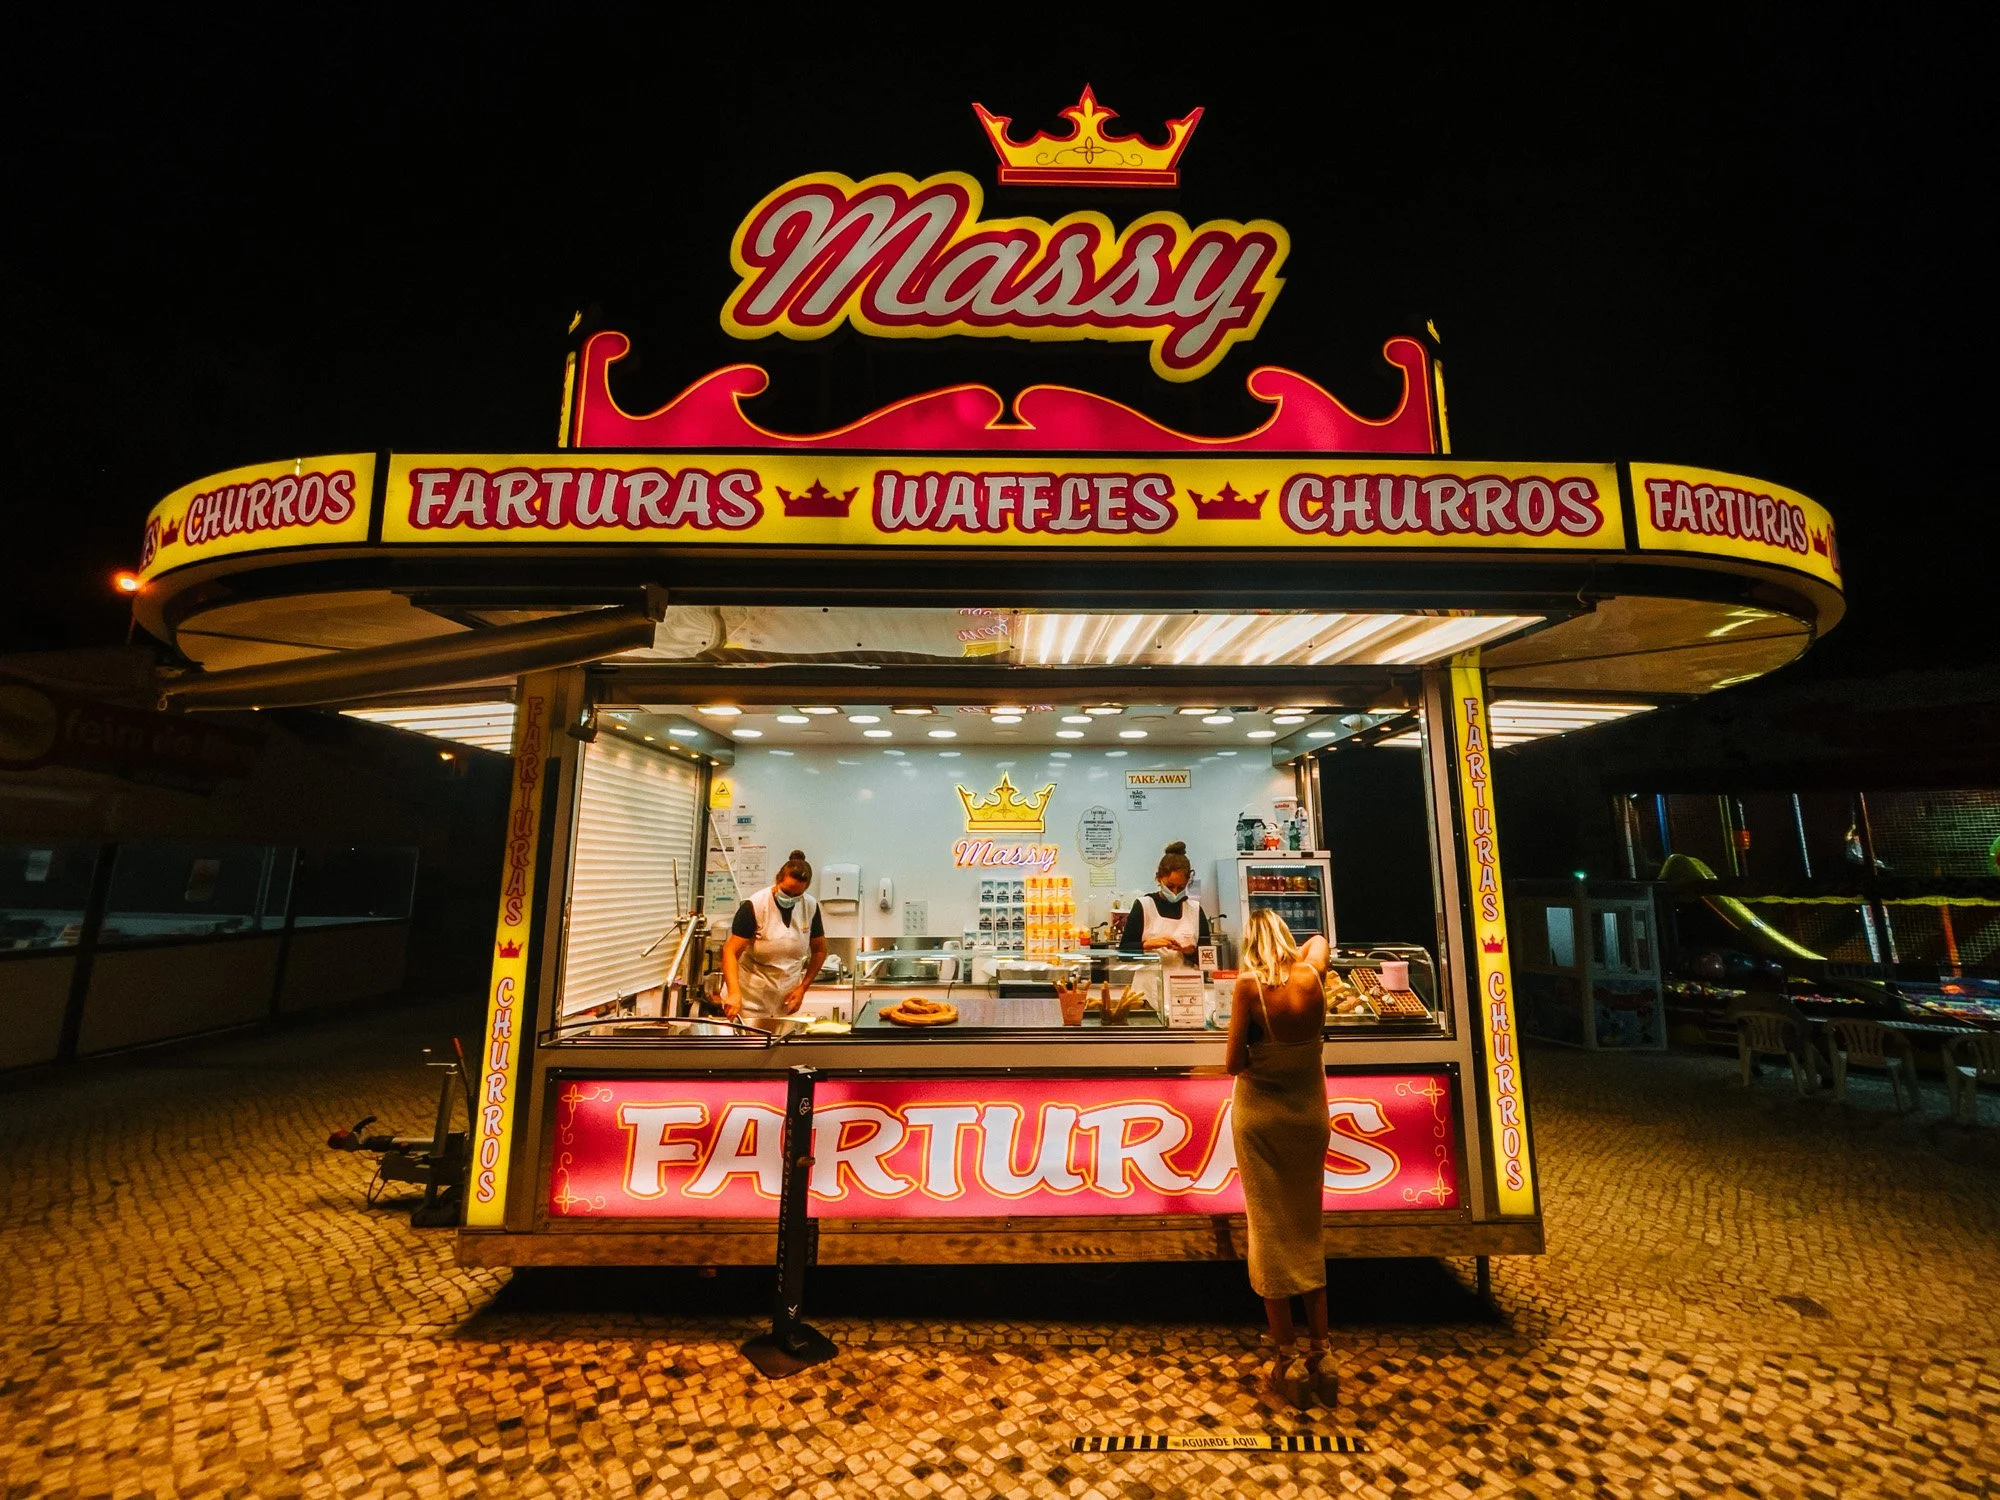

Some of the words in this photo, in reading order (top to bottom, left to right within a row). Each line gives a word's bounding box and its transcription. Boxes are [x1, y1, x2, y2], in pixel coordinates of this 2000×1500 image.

[738, 187, 1271, 365] Massy
[186, 472, 353, 545] CHURROS
[413, 470, 761, 529] FARTURAS
[876, 472, 1176, 531] WAFFLES
[1283, 475, 1601, 534] CHURROS
[1648, 481, 1807, 553] FARTURAS
[504, 696, 544, 927] FARTURAS
[1128, 774, 1188, 784] TAKE-AWAY
[956, 840, 1058, 872] Massy
[1463, 697, 1499, 922] FARTURAS
[1487, 971, 1525, 1191] CHURROS
[476, 976, 515, 1203] CHURROS
[1181, 1437, 1230, 1448] AGUARDE
[1233, 1437, 1259, 1447] AQUI
